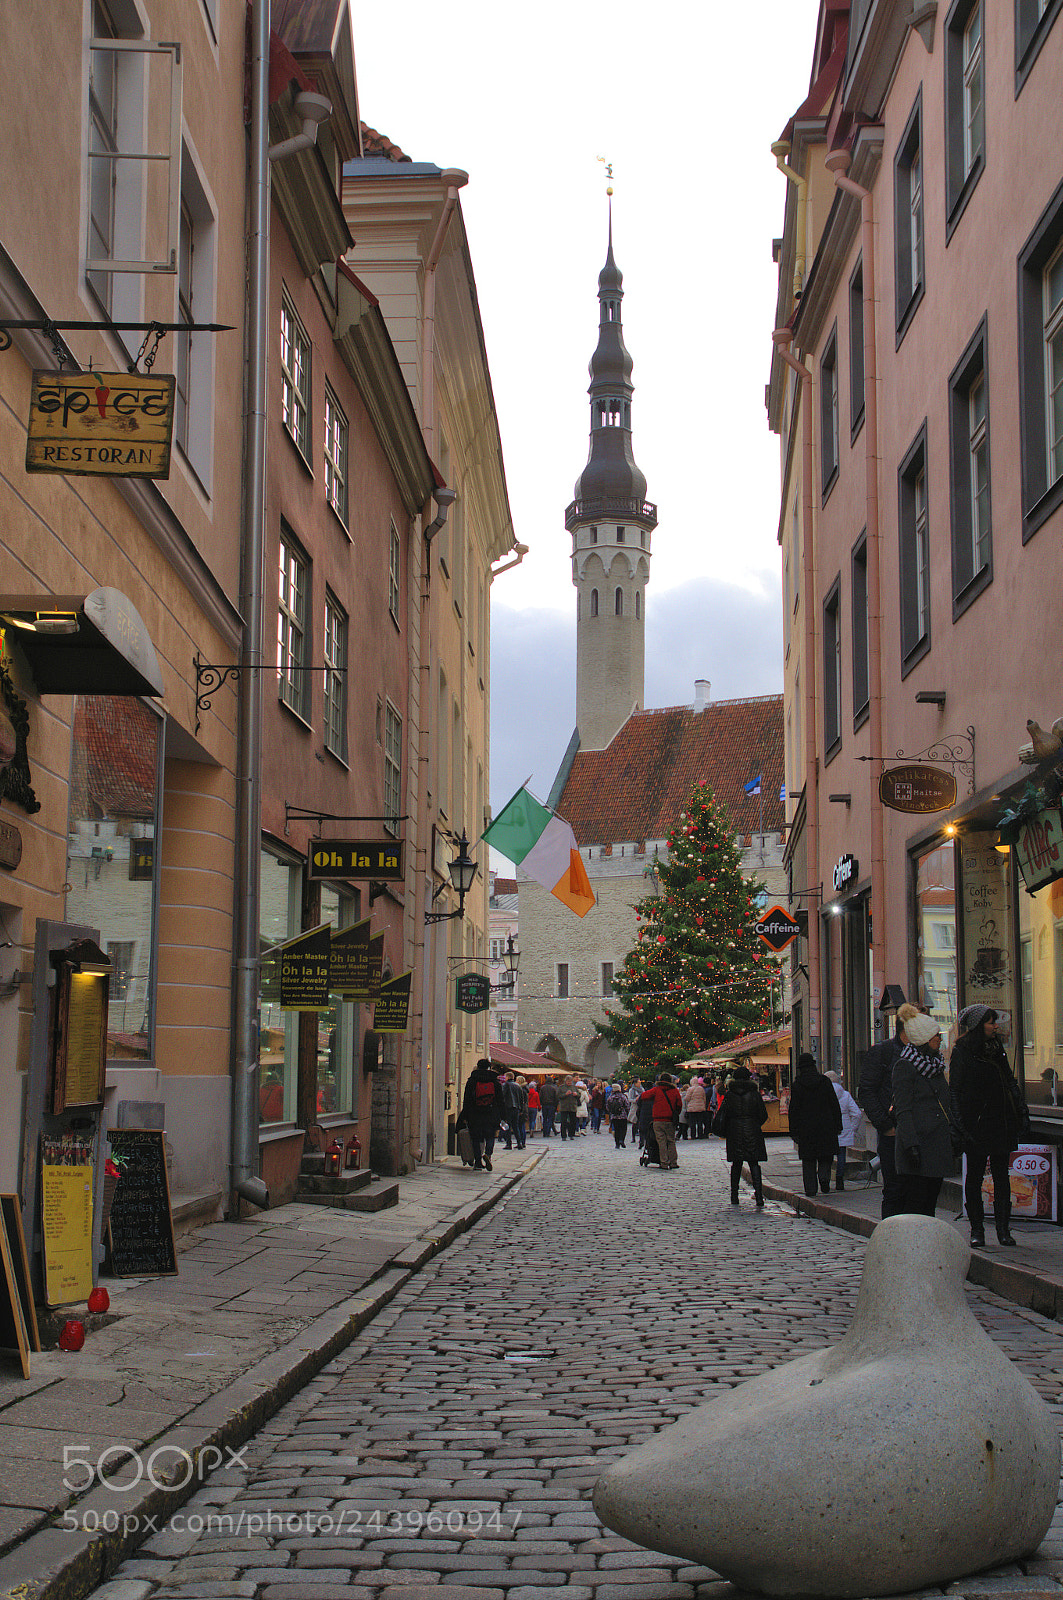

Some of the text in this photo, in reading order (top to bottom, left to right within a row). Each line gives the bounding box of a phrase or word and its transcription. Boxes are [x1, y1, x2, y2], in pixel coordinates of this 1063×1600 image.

[43, 445, 152, 464] RESTORAN
[888, 770, 949, 785] Delikatess
[313, 851, 398, 868] Oh la la
[969, 884, 998, 898] Coffee
[755, 921, 800, 935] Caffeine
[329, 954, 344, 963] Oh
[346, 954, 356, 963] la
[359, 954, 369, 963] la
[282, 965, 328, 976] Oh la la
[300, 977, 328, 986] Jewelry
[1017, 1159, 1047, 1171] 3,50 €
